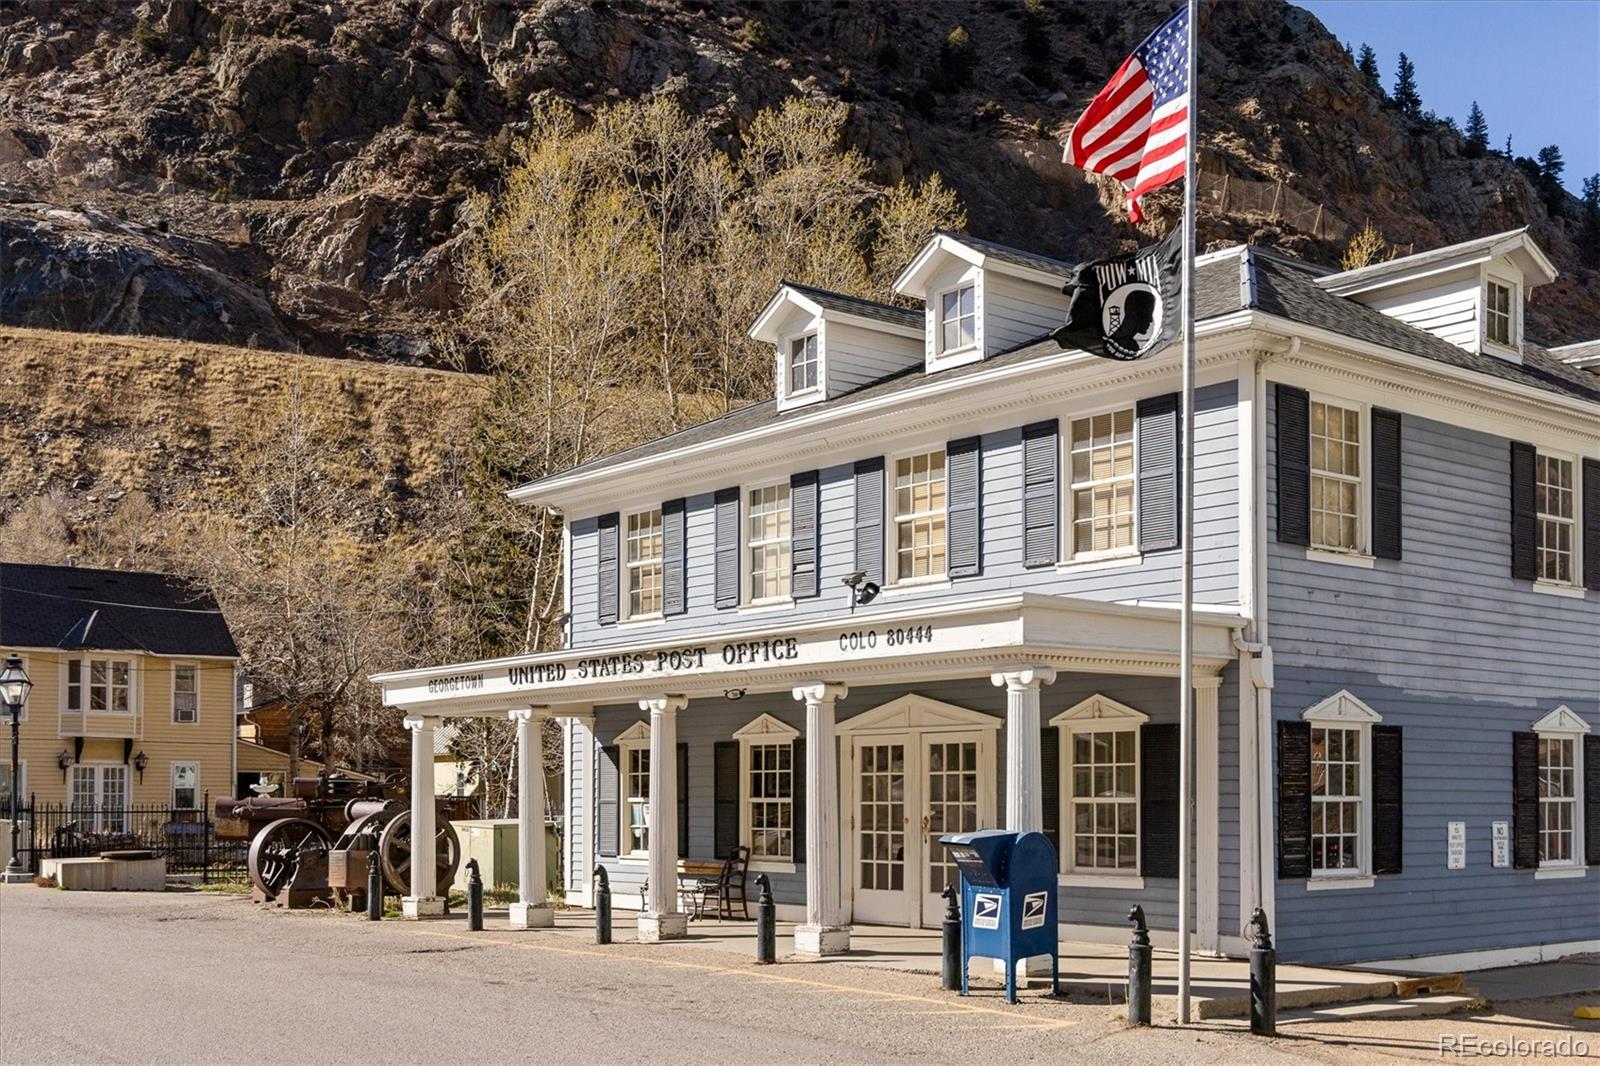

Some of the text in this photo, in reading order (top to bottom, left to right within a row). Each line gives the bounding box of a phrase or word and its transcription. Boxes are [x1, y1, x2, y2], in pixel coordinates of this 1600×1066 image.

[1094, 254, 1162, 307] POW MIA
[428, 624, 933, 693] GEORGETOWN UNITED STATES POST OFFICE COLO 80444
[1496, 827, 1504, 836] NO
